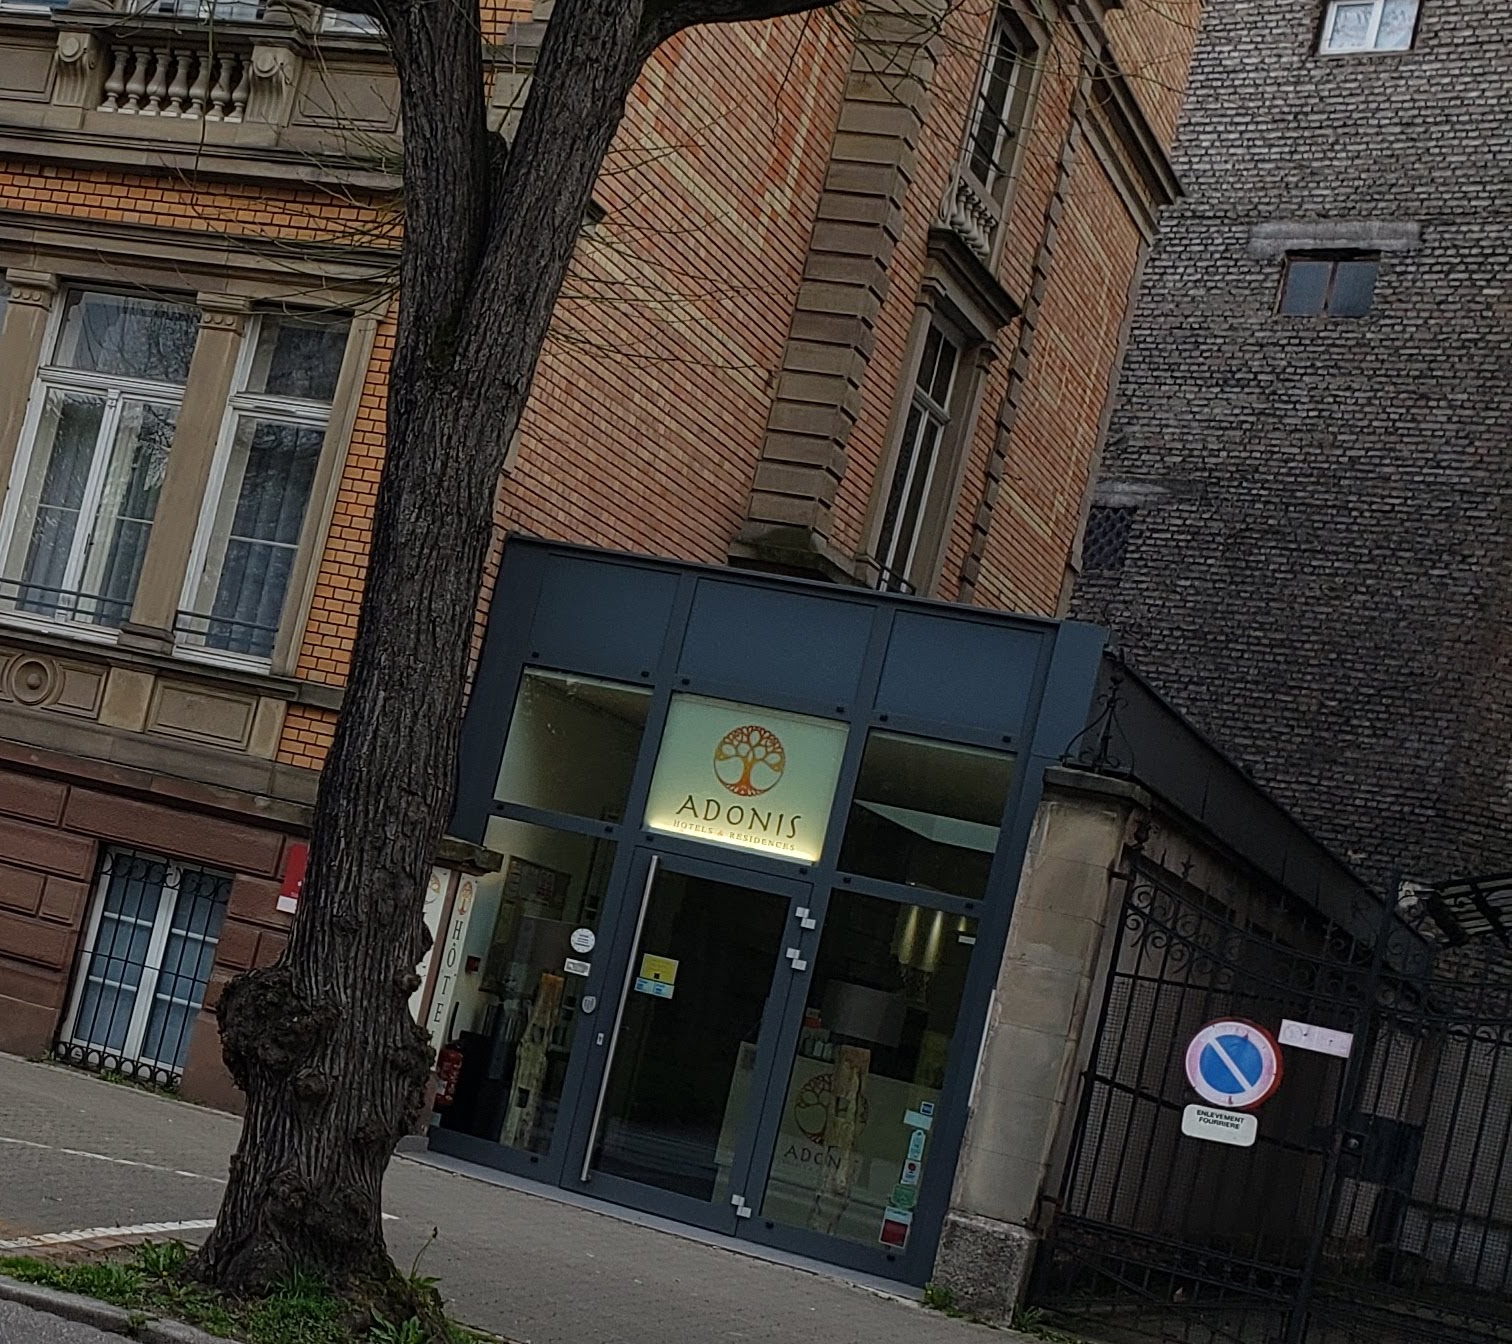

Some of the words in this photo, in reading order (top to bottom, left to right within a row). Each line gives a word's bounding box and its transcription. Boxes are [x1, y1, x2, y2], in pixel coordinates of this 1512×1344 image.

[675, 794, 802, 839] ADONIS
[672, 819, 714, 835] HOTELS
[729, 831, 795, 851] RESIDENCES
[1196, 1110, 1244, 1123] ENLEVEMENT
